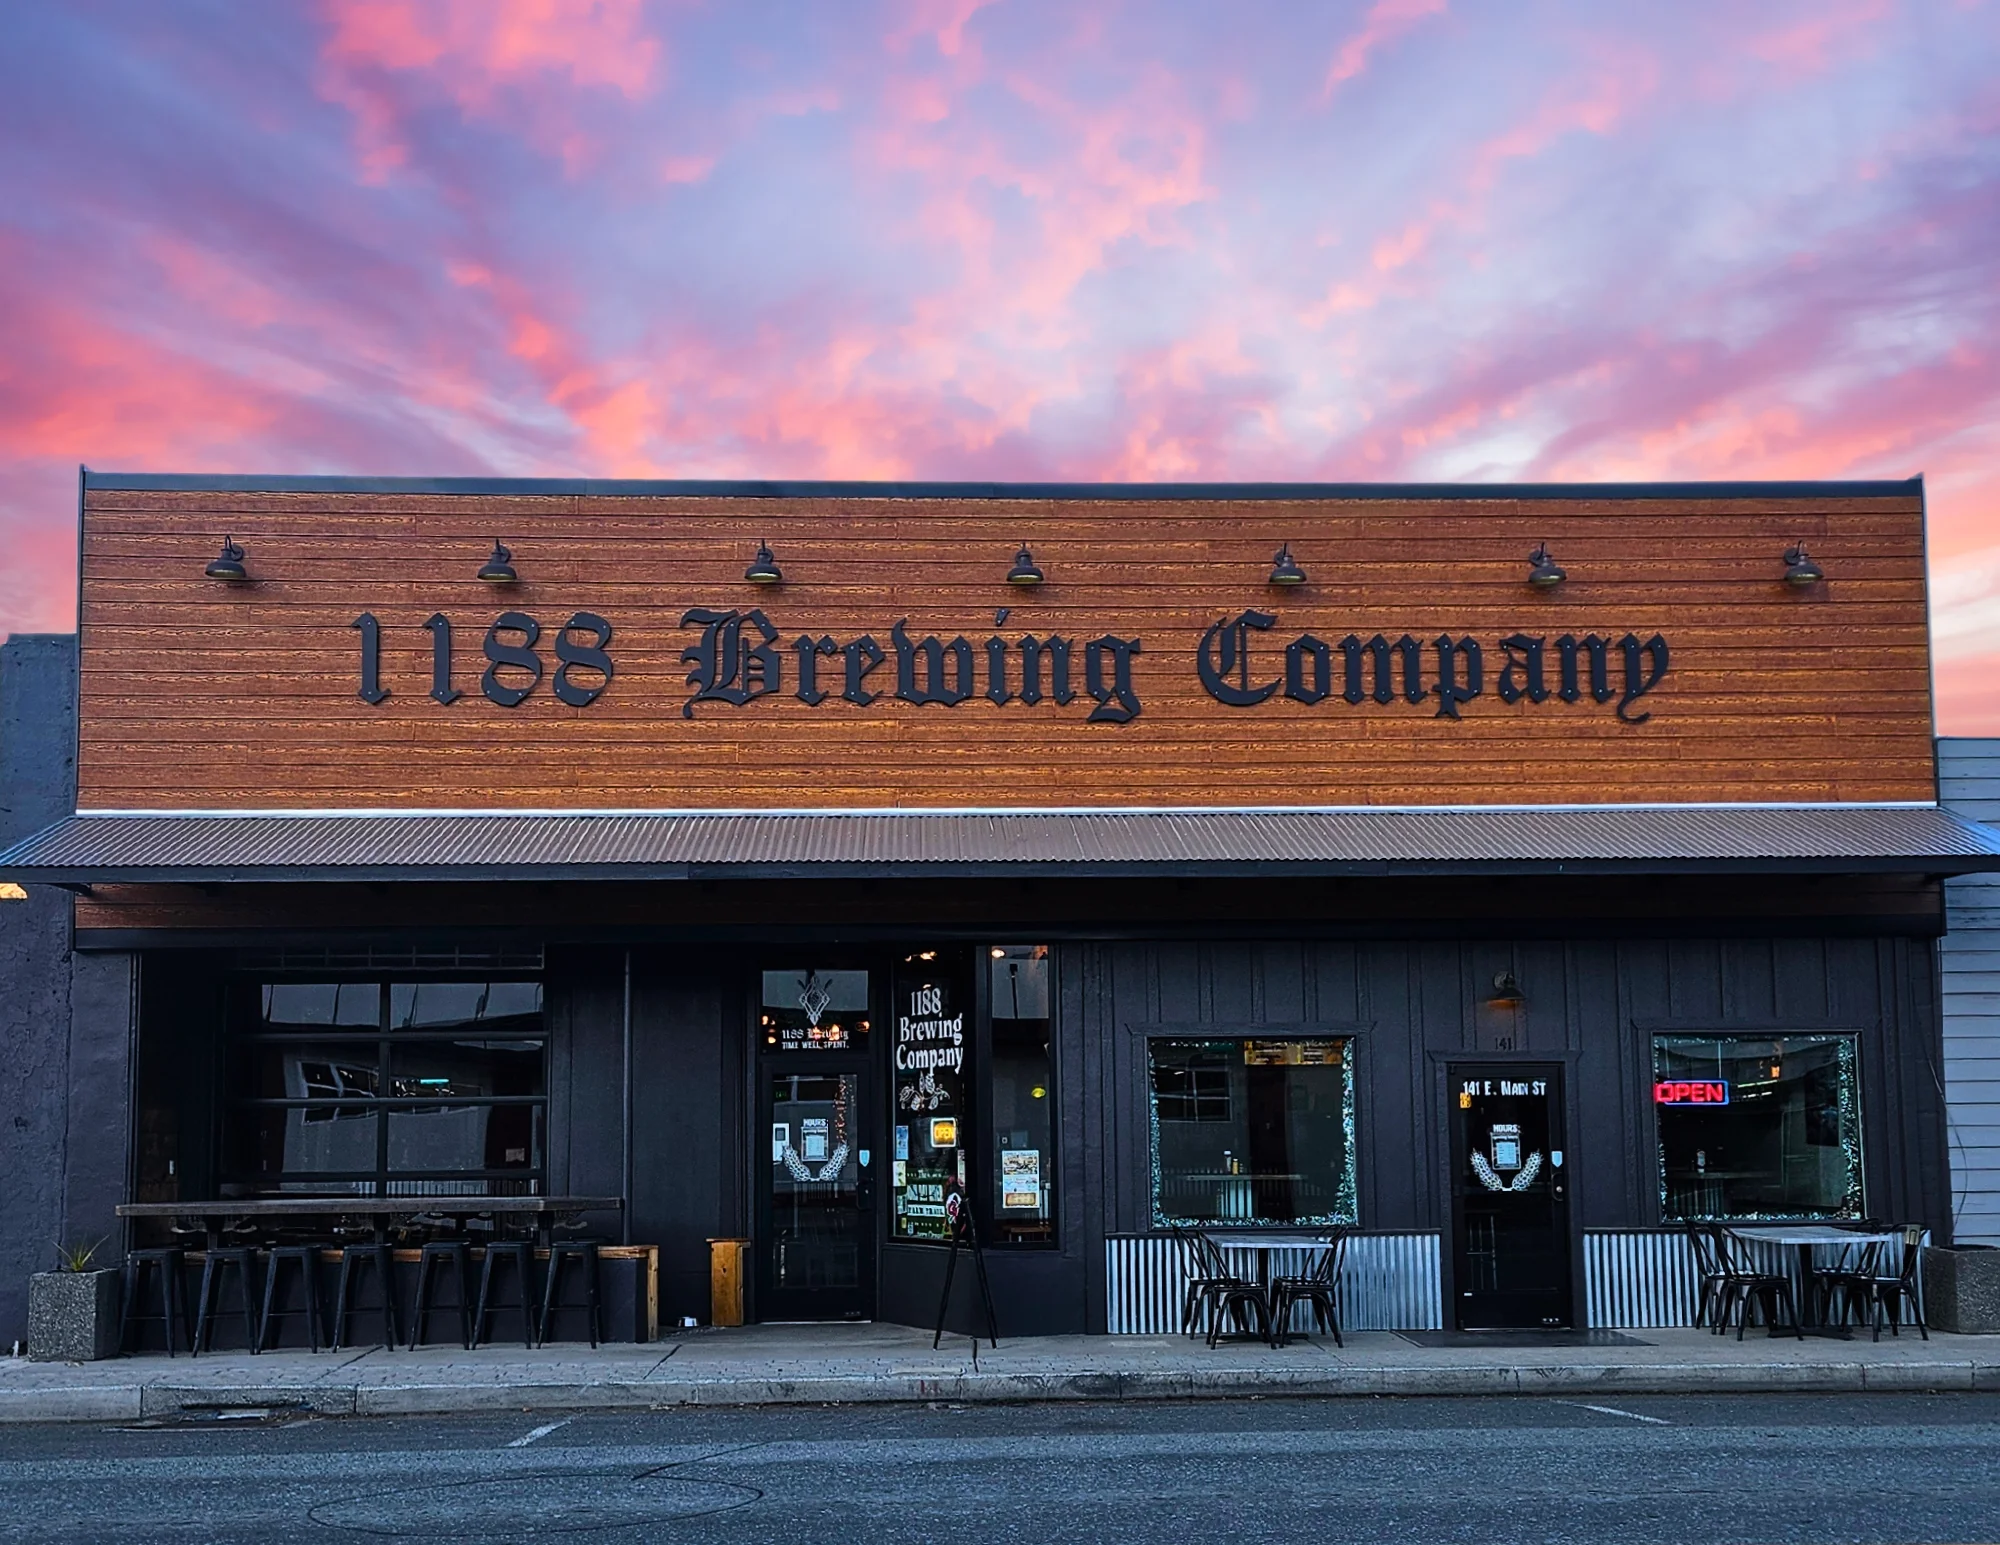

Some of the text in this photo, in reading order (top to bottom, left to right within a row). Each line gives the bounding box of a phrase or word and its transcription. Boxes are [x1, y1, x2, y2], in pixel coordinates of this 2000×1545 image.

[352, 606, 1671, 724] 1188 Brewing Company
[910, 987, 942, 1016] 1188
[782, 1027, 850, 1040] 1188 Bewng
[899, 1012, 963, 1046] Brewing
[781, 1041, 799, 1050] TIME
[801, 1040, 822, 1050] WELL
[1495, 1037, 1512, 1050] 141
[896, 1044, 964, 1076] Company
[1463, 1081, 1480, 1096] 141
[1484, 1081, 1497, 1096] E.
[1532, 1081, 1547, 1096] ST
[1654, 1083, 1723, 1103] OPEN
